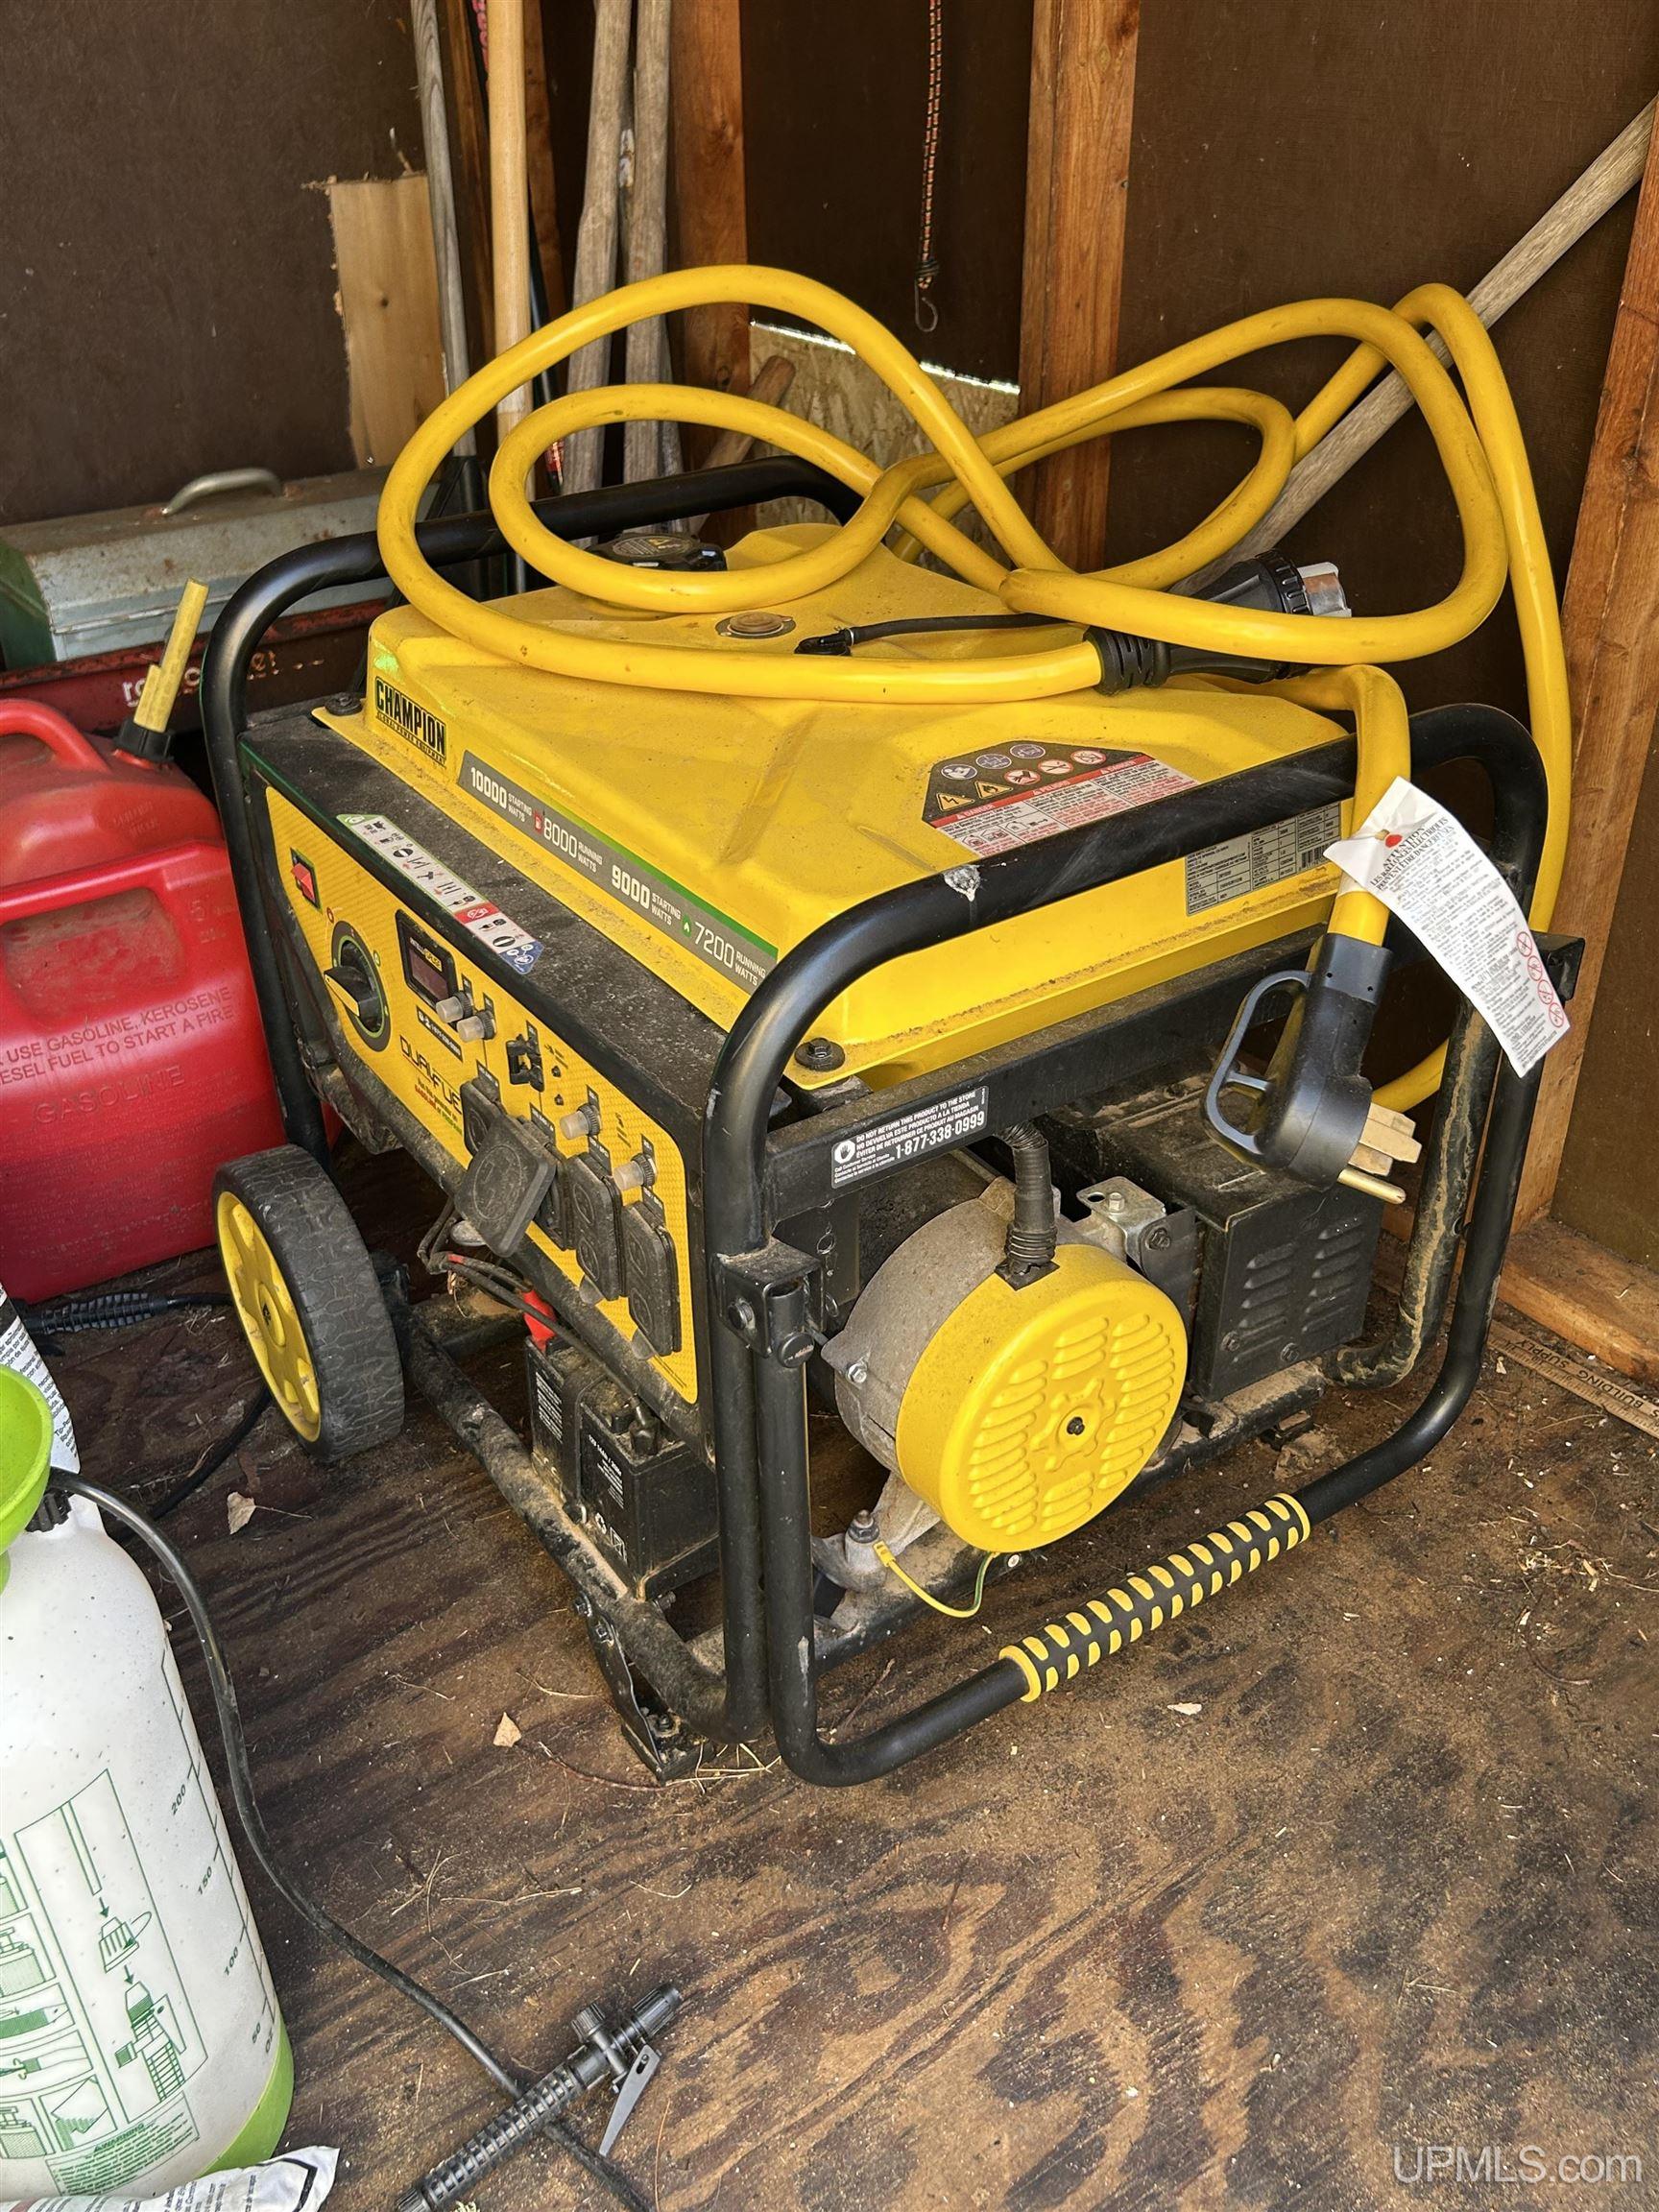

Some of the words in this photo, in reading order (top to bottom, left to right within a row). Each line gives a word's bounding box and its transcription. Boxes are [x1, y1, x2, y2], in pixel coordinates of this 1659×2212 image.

[376, 679, 445, 757] CHAMPION
[1382, 828, 1426, 870] ATTENTION
[470, 767, 508, 809] 10000
[508, 793, 533, 817] STARTING
[543, 818, 577, 858] 8000
[578, 841, 603, 866] RUNNING
[612, 865, 650, 909] 9000
[652, 893, 682, 920] STARTING
[694, 922, 735, 969] 7200
[735, 950, 766, 979] RUNNING
[1370, 875, 1382, 886] LES
[1376, 866, 1403, 891] PEUVENT
[508, 805, 525, 823] WATTS
[578, 854, 597, 873] WATTS
[651, 903, 672, 926] WATTS
[734, 962, 758, 987] WATTS
[6, 1042, 43, 1064] USE
[47, 1017, 140, 1052] GASOLINE,
[142, 986, 232, 1025] KEROSENE
[0, 1064, 46, 1086] ESEL
[49, 1047, 94, 1072] FUEL
[95, 1040, 120, 1058] TO
[125, 1022, 178, 1050] START
[181, 1018, 195, 1034] A
[197, 1007, 235, 1030] FIRE
[35, 1065, 185, 1124] GASOLINE
[856, 1134, 865, 1143] DO
[866, 1129, 878, 1140] NOT
[878, 1121, 901, 1135] RETURN
[901, 1115, 913, 1126] THIS
[914, 1104, 939, 1121] PRODUCT
[949, 1097, 958, 1107] THE
[959, 1091, 976, 1103] STORE
[856, 1142, 865, 1150] NO
[866, 1131, 894, 1147] DEVUELVA
[894, 1126, 908, 1137] ESTE
[908, 1114, 937, 1131] PRODUCTO
[950, 1101, 970, 1114] TIENDA
[884, 1130, 916, 1147] RETOURNER
[916, 1126, 924, 1135] CE
[924, 1118, 947, 1132] PRODUIT
[954, 1105, 979, 1119] MAGASIN
[896, 1111, 985, 1160] 1-877-338-0999
[1516, 1339, 1569, 1369] SUPPLY
[1576, 1369, 1645, 1408] BUILDING
[171, 1784, 186, 1815] 200
[197, 1865, 213, 1896] 150
[224, 1946, 239, 1977] 100
[252, 2021, 261, 2045] 50
